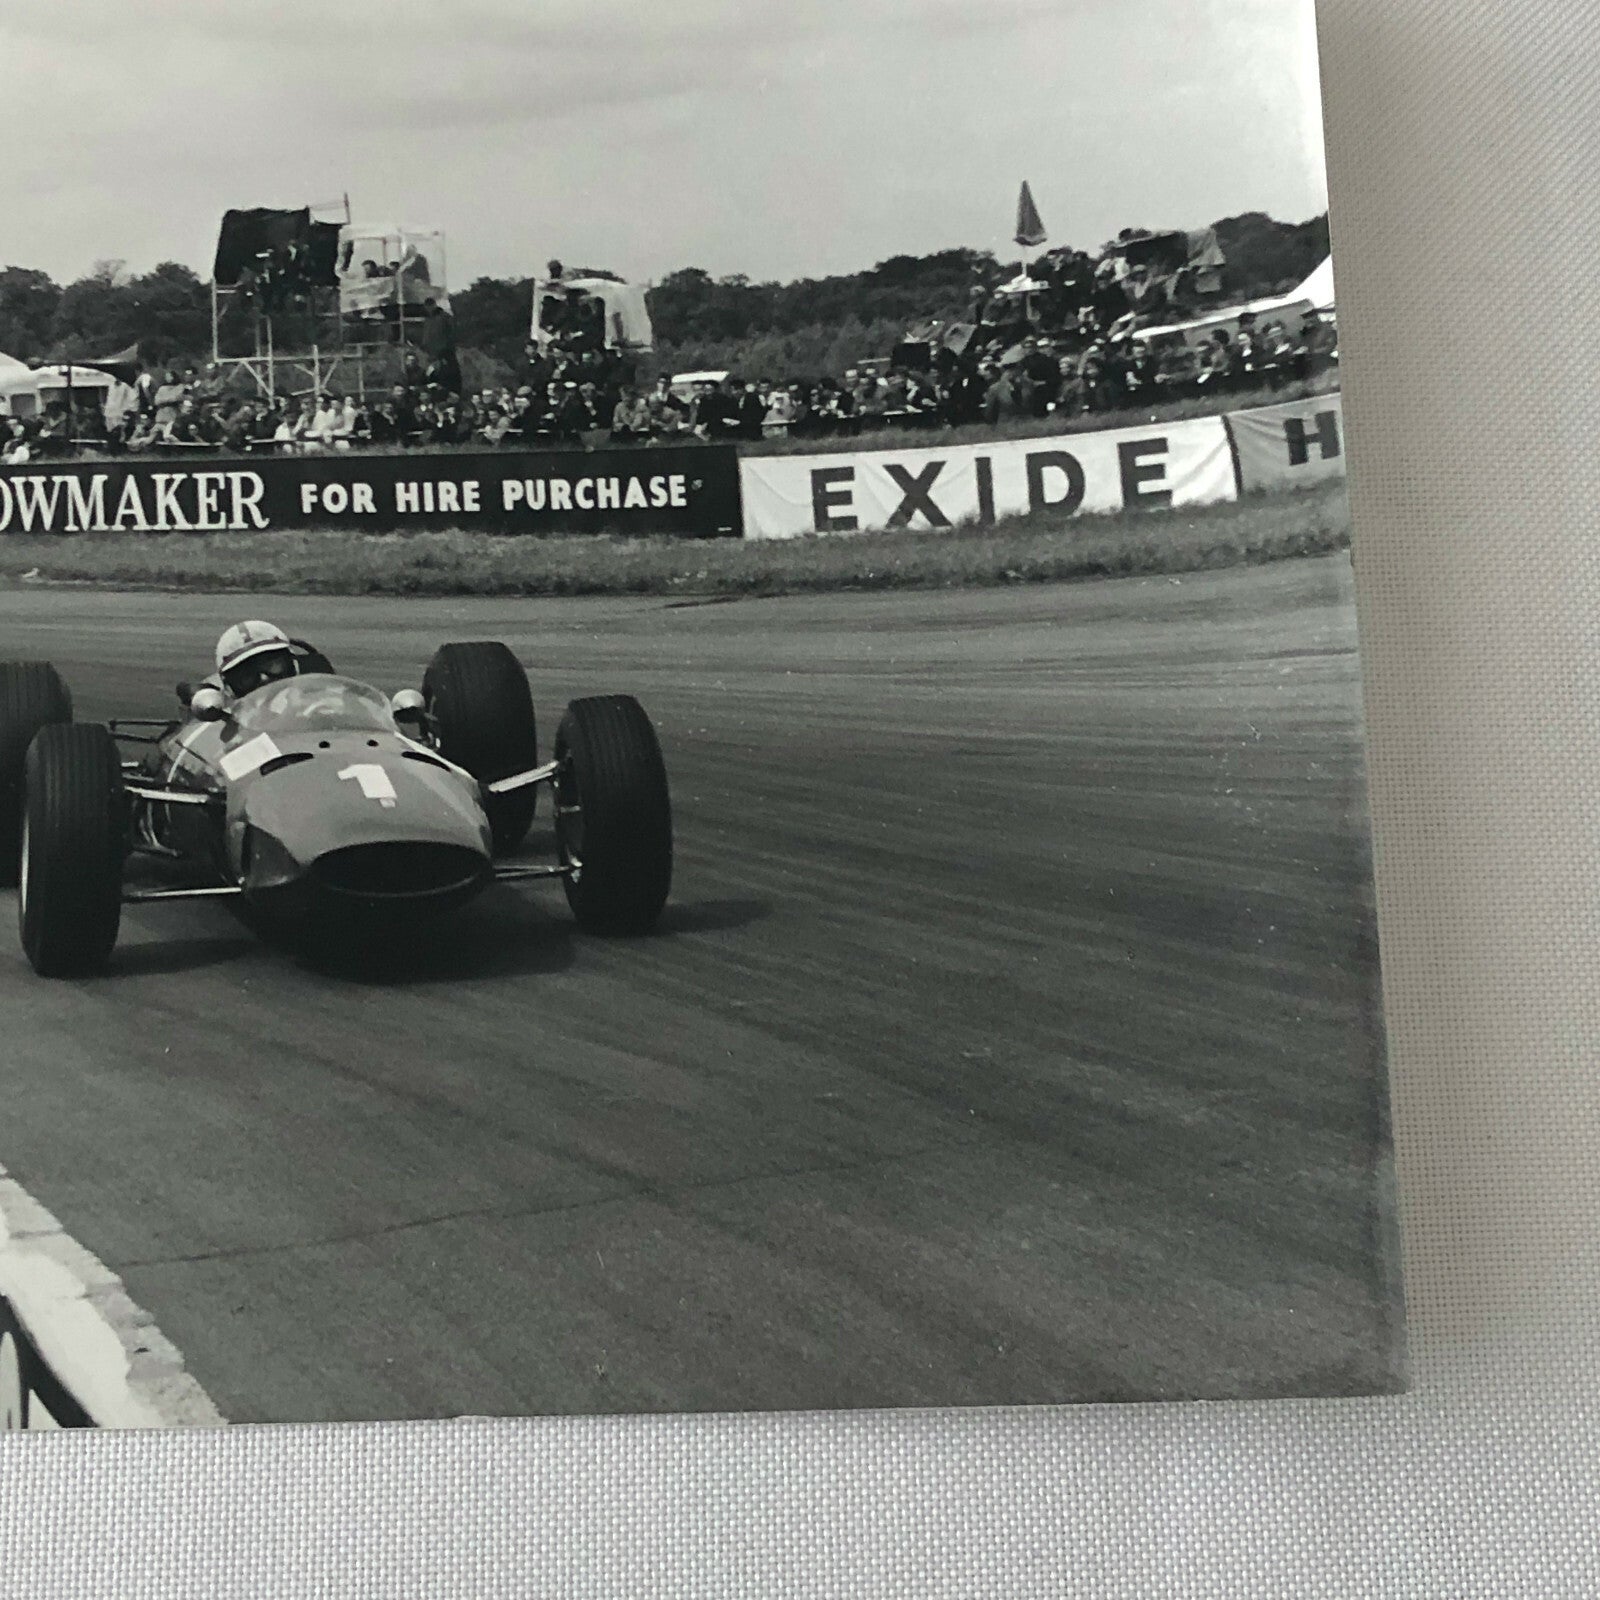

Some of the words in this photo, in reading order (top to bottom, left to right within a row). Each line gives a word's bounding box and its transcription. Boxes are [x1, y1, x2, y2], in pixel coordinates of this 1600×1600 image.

[300, 482, 377, 514] FOR
[395, 480, 481, 513] HIRE
[502, 474, 687, 511] PURCHASE
[810, 436, 1173, 532] EXIDE
[337, 763, 397, 808] 1
